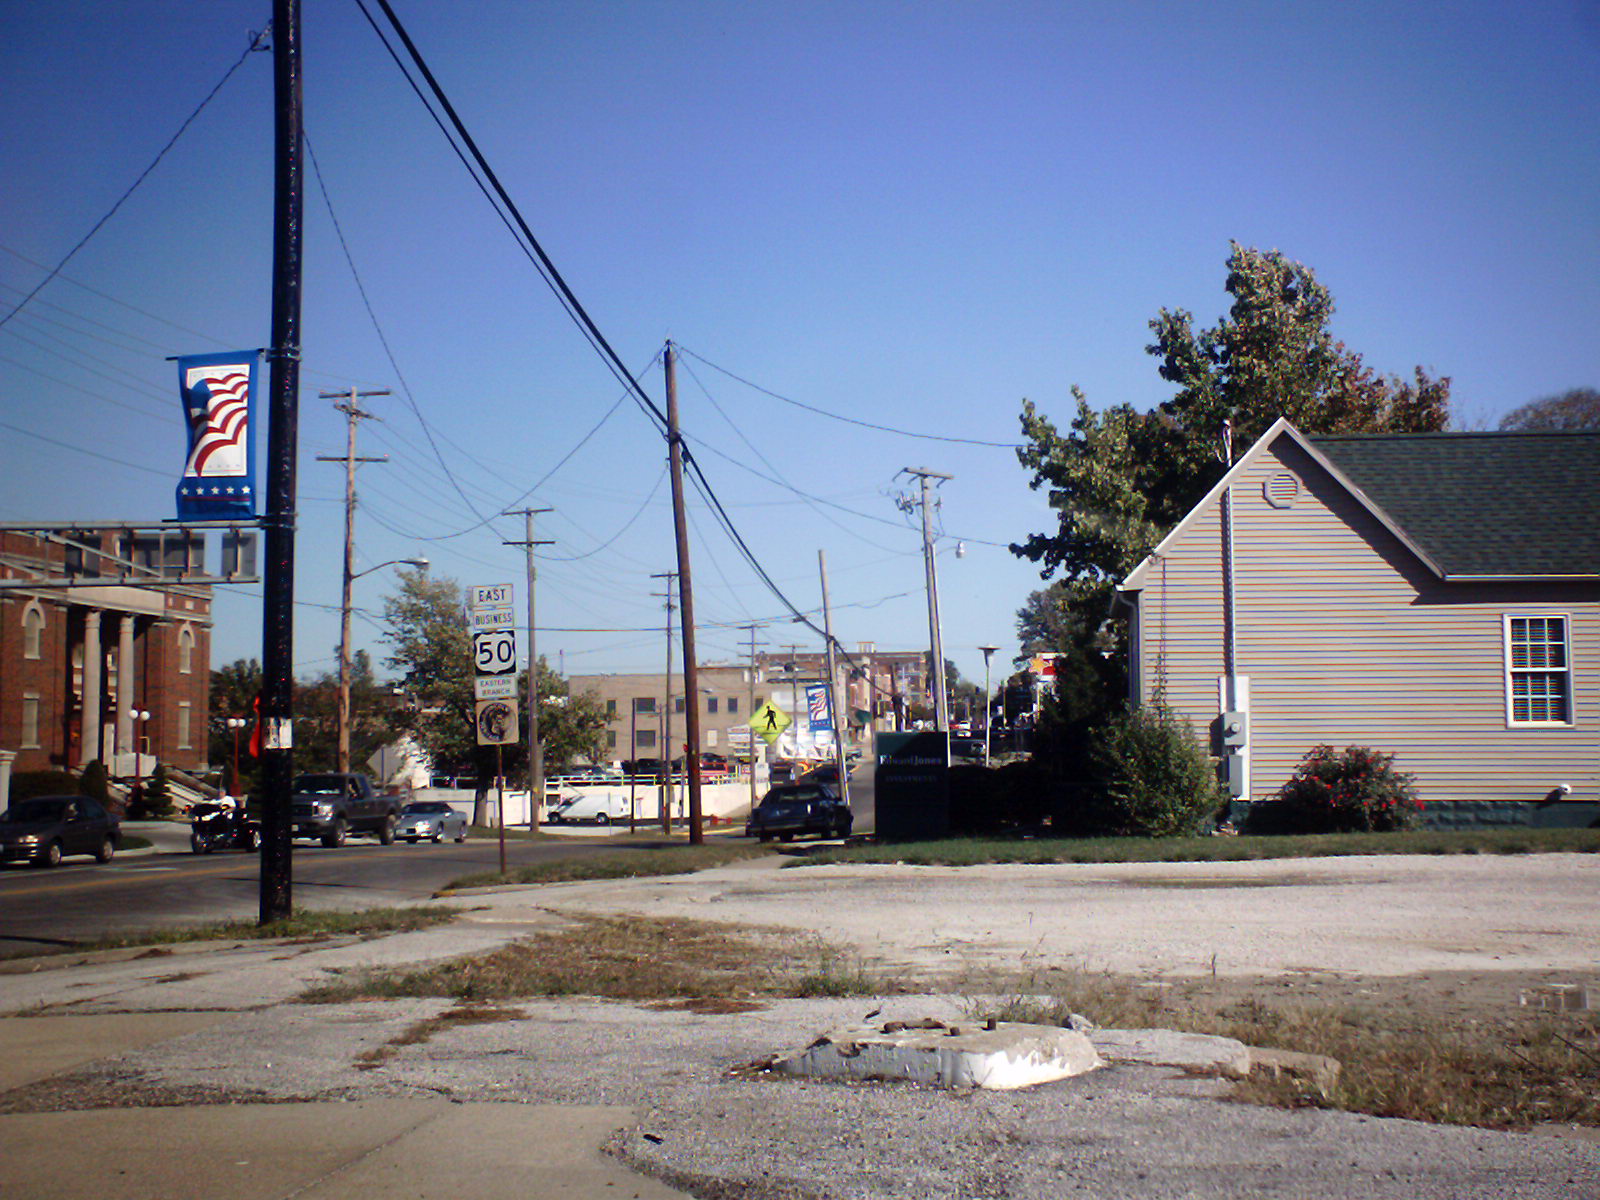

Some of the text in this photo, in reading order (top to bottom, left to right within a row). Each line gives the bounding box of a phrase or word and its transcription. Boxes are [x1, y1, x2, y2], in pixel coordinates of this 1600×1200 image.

[478, 589, 506, 602] EAST
[475, 612, 513, 626] BUSINESS
[479, 640, 512, 665] 50
[480, 679, 511, 687] EASTERN
[482, 688, 511, 697] BRANCH
